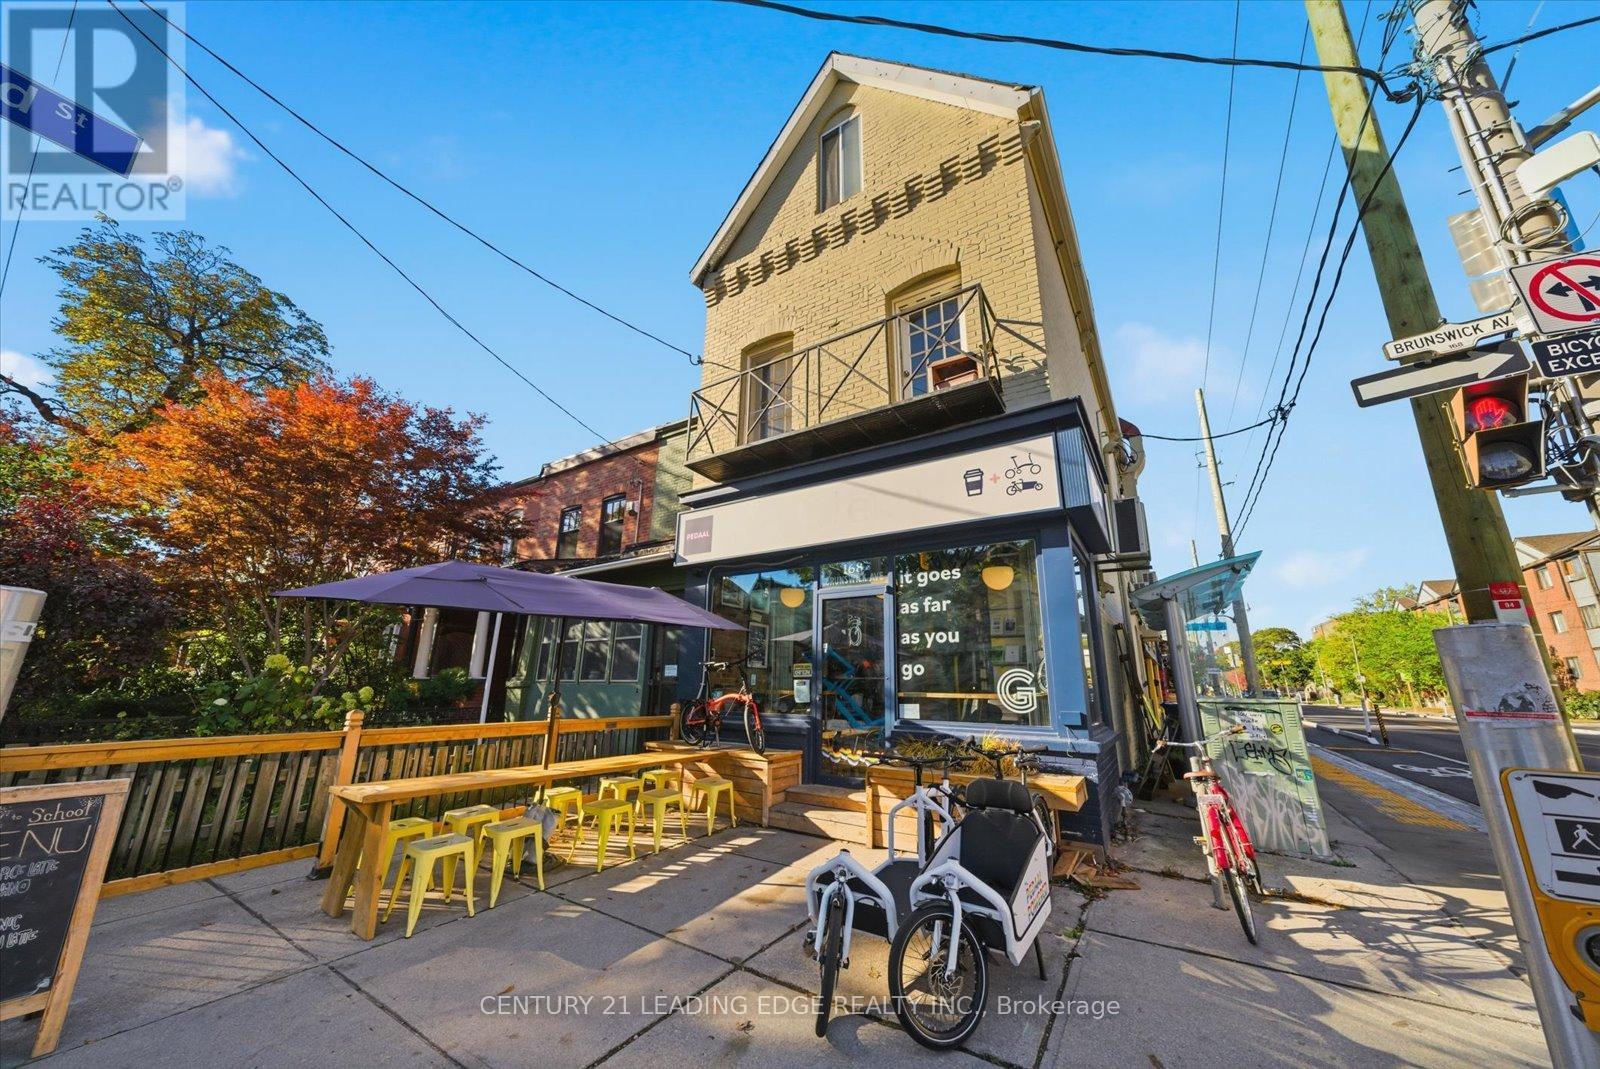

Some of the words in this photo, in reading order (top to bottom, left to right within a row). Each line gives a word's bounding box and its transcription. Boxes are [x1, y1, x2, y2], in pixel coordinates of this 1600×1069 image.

[1393, 323, 1484, 354] BRUNSWICK
[686, 531, 709, 540] PEDAAL
[843, 562, 864, 576] 168
[900, 570, 913, 586] it
[917, 568, 962, 587] goes
[900, 601, 919, 614] as
[923, 597, 951, 613] far
[900, 632, 920, 645] as
[925, 630, 960, 648] you
[901, 663, 925, 681] go
[28, 801, 92, 824] School
